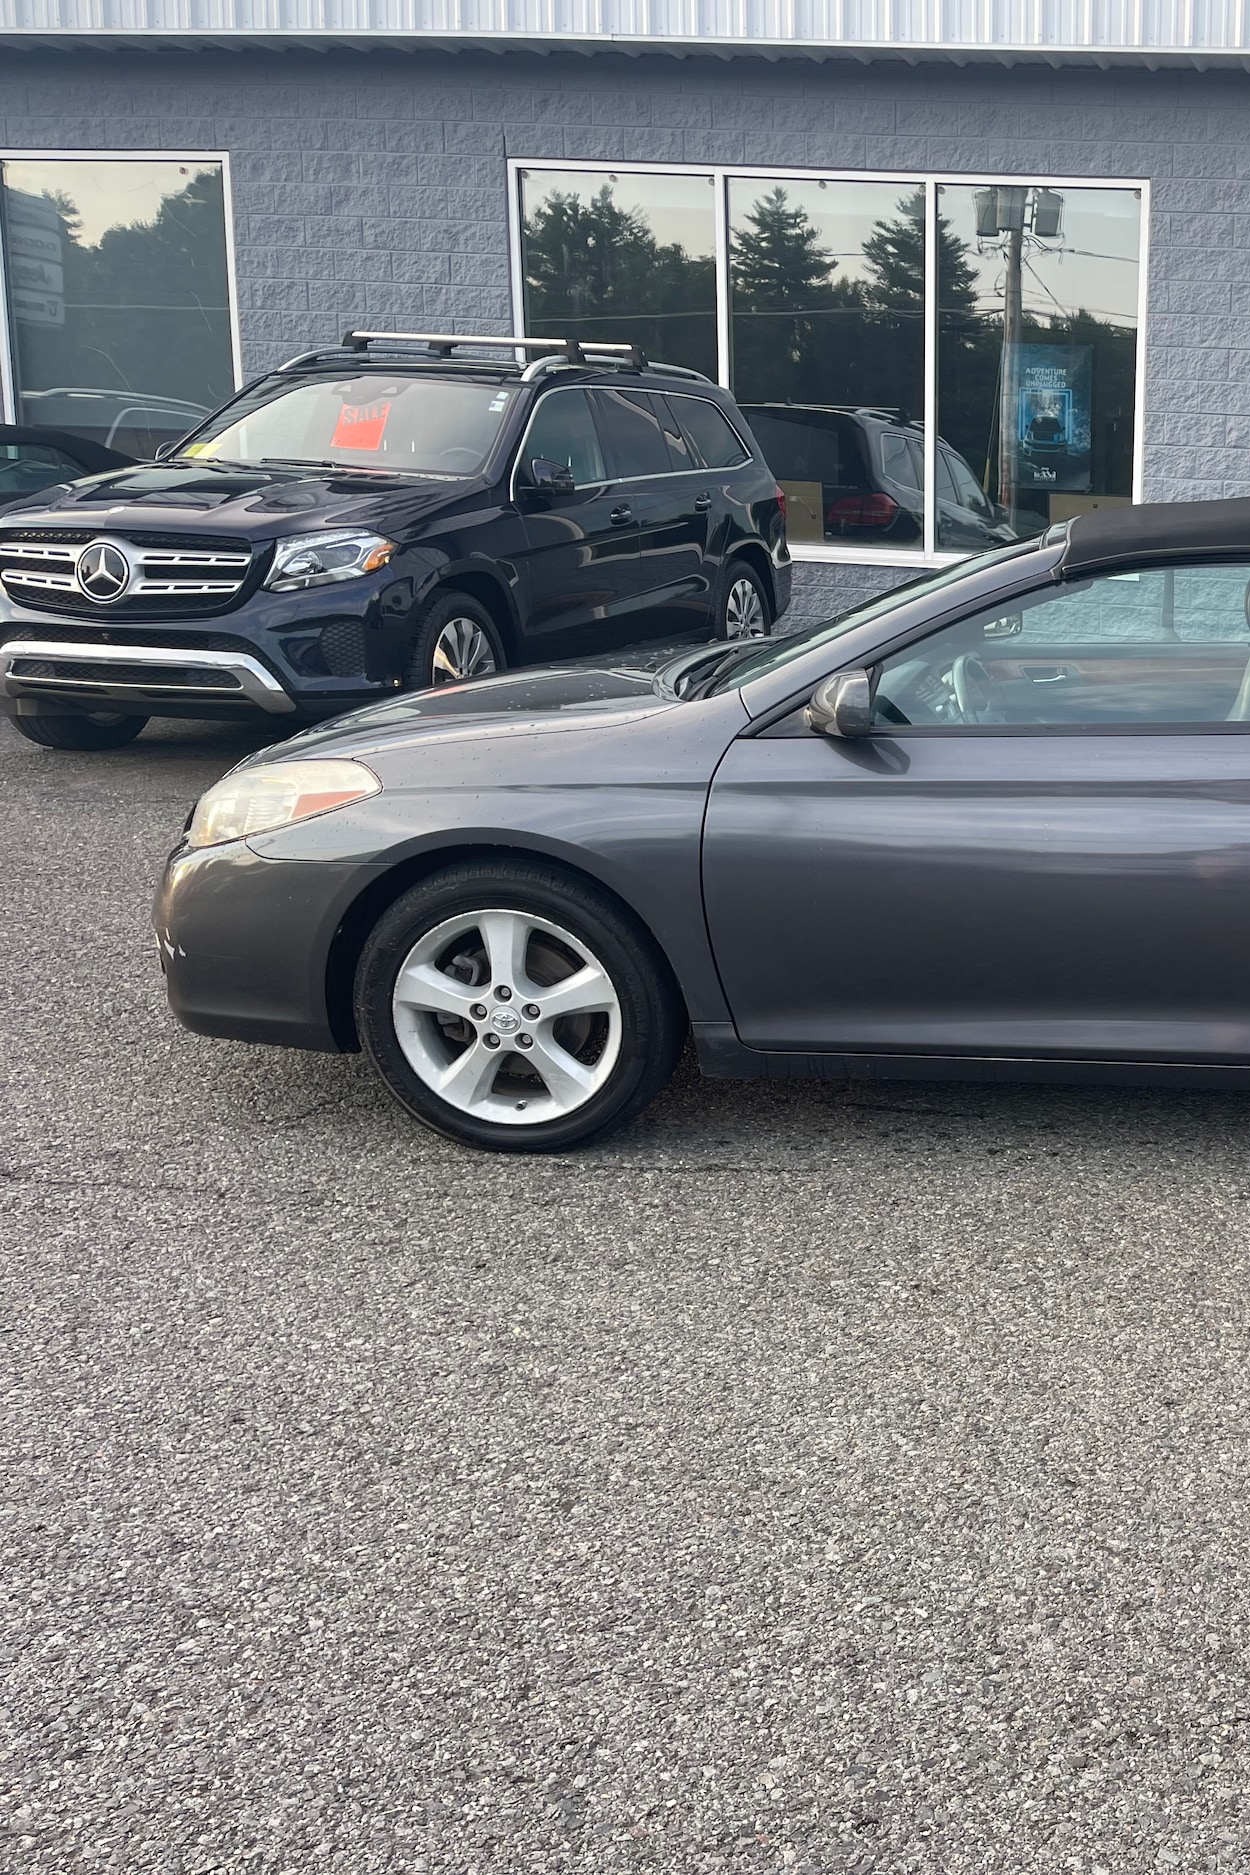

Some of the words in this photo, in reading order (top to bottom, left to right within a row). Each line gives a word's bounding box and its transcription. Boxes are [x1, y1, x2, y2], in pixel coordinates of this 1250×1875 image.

[1025, 367, 1067, 376] ADVENTURE
[1025, 380, 1066, 389] UNPLUGGED
[342, 403, 386, 426] SALE
